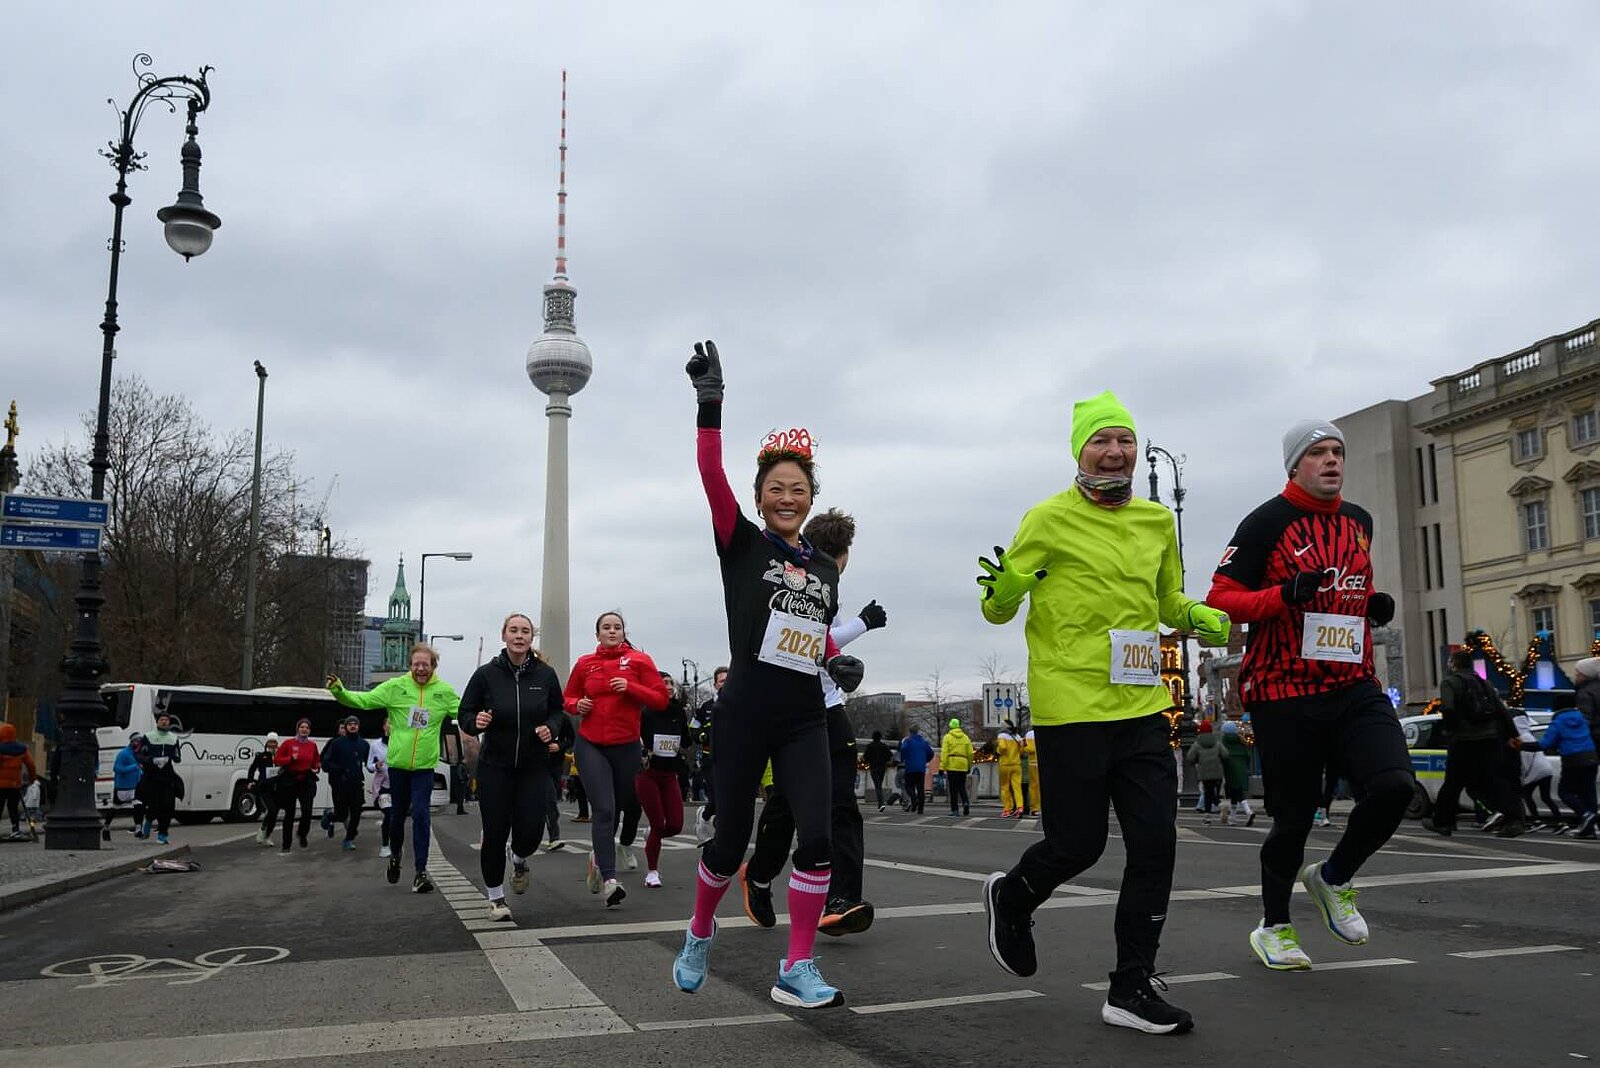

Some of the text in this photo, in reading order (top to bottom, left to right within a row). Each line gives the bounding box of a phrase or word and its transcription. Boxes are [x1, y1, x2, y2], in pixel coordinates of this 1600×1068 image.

[764, 428, 812, 449] 2026
[776, 627, 822, 660] 2026
[1316, 626, 1355, 648] 2026
[1123, 643, 1154, 669] 2026
